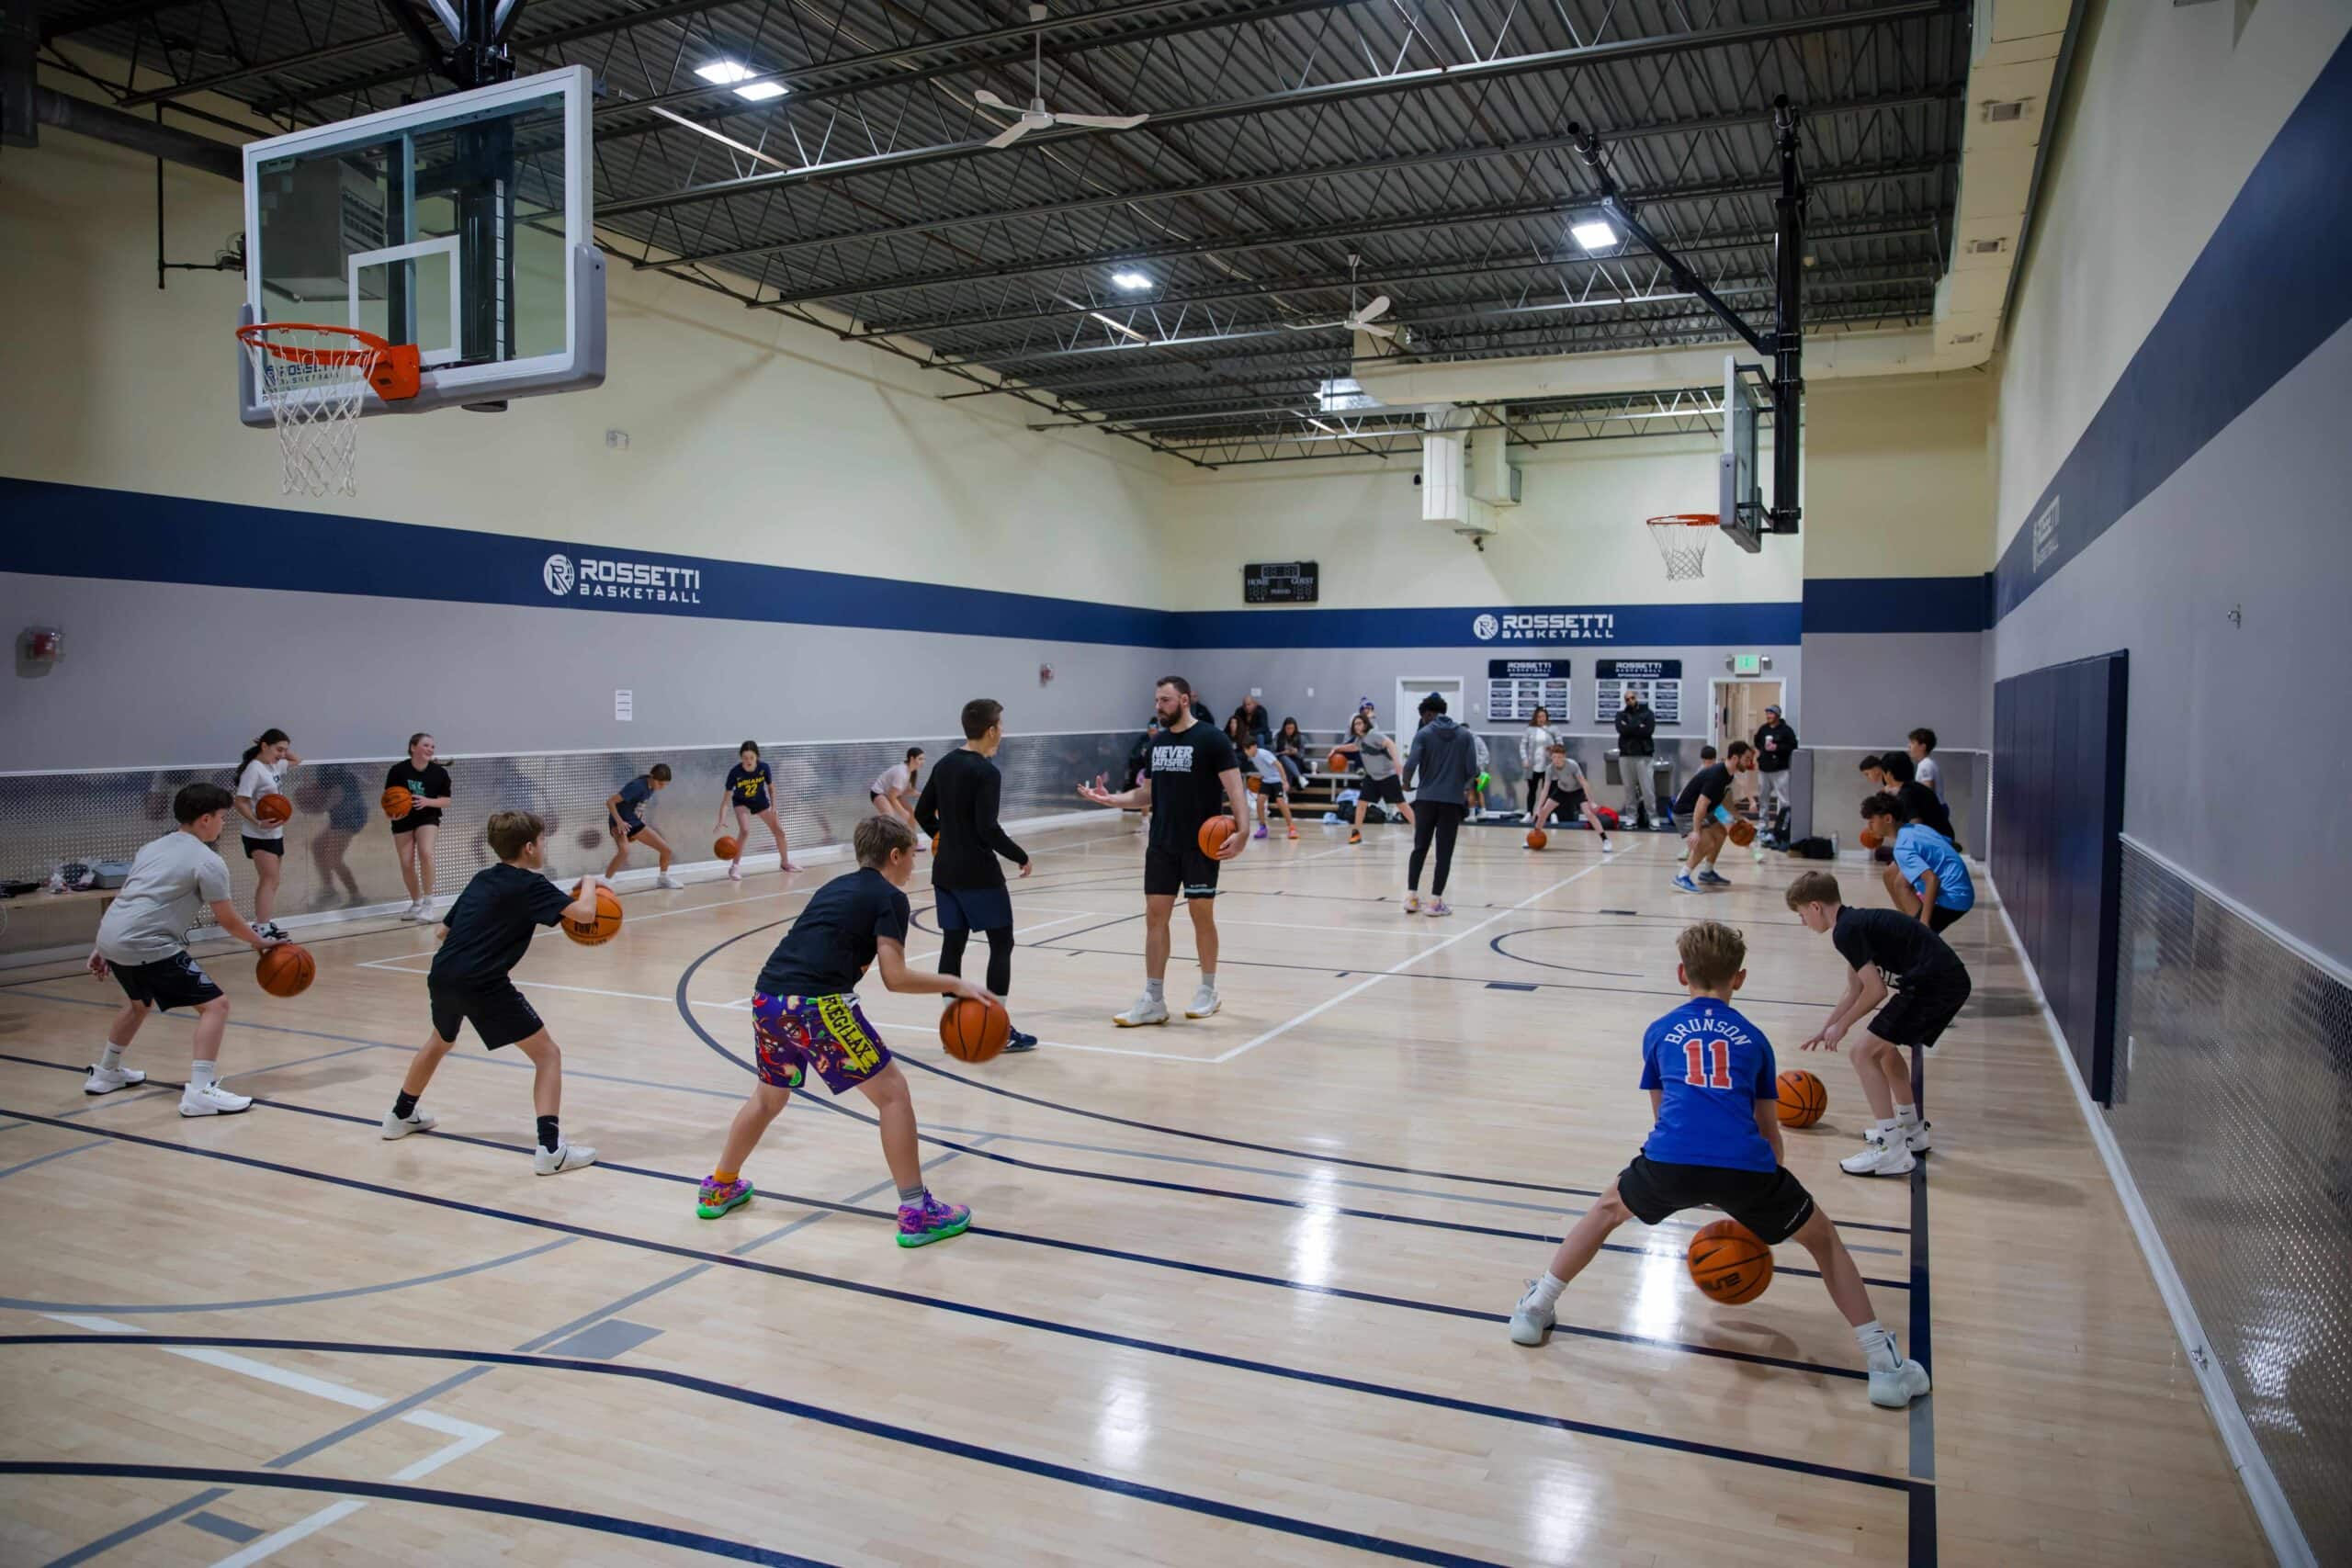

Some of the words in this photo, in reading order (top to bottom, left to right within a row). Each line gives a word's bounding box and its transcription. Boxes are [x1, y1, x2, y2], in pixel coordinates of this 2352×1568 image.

[580, 558, 700, 590] ROSSETTI
[580, 583, 700, 604] BASKETBALL
[1502, 615, 1613, 629] ROSSETTI
[1502, 630, 1613, 638] BASKETBALL
[1152, 746, 1193, 758] NEVER
[1664, 1018, 1752, 1045] BRUNSON
[1682, 1038, 1733, 1089] 11
